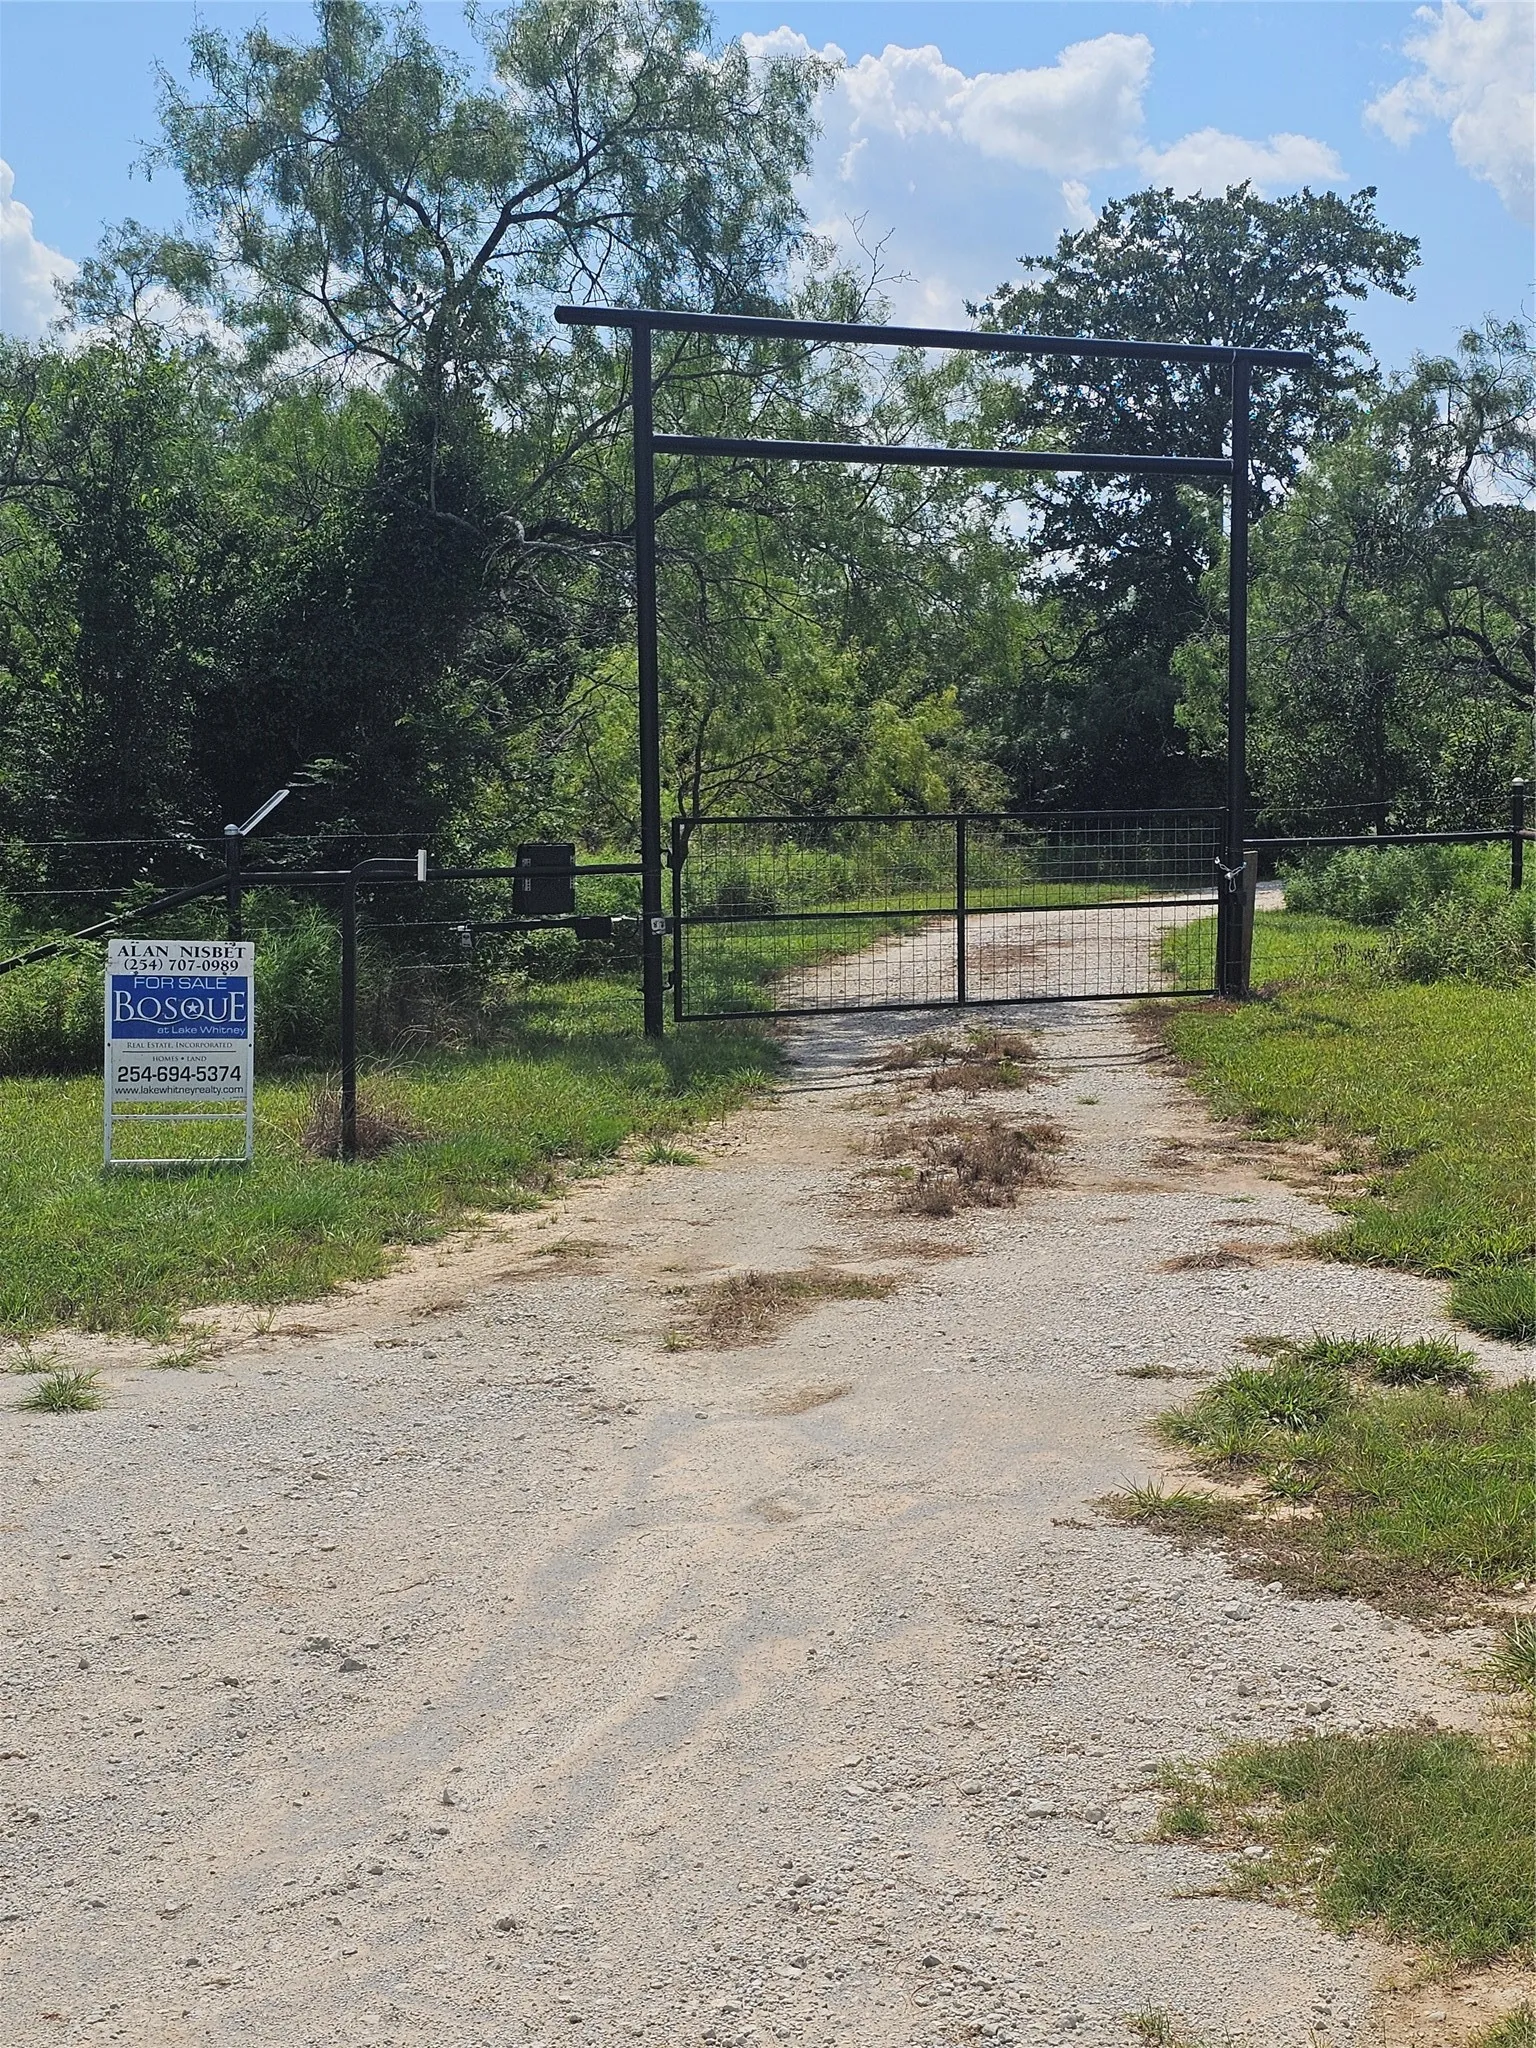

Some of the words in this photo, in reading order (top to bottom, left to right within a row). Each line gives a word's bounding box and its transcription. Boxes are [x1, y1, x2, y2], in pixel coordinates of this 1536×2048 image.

[117, 945, 169, 957] ALAN
[180, 946, 246, 958] NISBET
[124, 958, 163, 971] (254)
[169, 959, 239, 972] 707-0989
[134, 977, 174, 989] FOR
[178, 977, 227, 989] SALE
[113, 990, 246, 1025] BOSQUE
[171, 1026, 198, 1034] Lake
[200, 1026, 246, 1036] Whitney
[117, 1066, 242, 1082] 254-694-5374
[114, 1085, 244, 1095] www.lakewhitneyrealty.com
